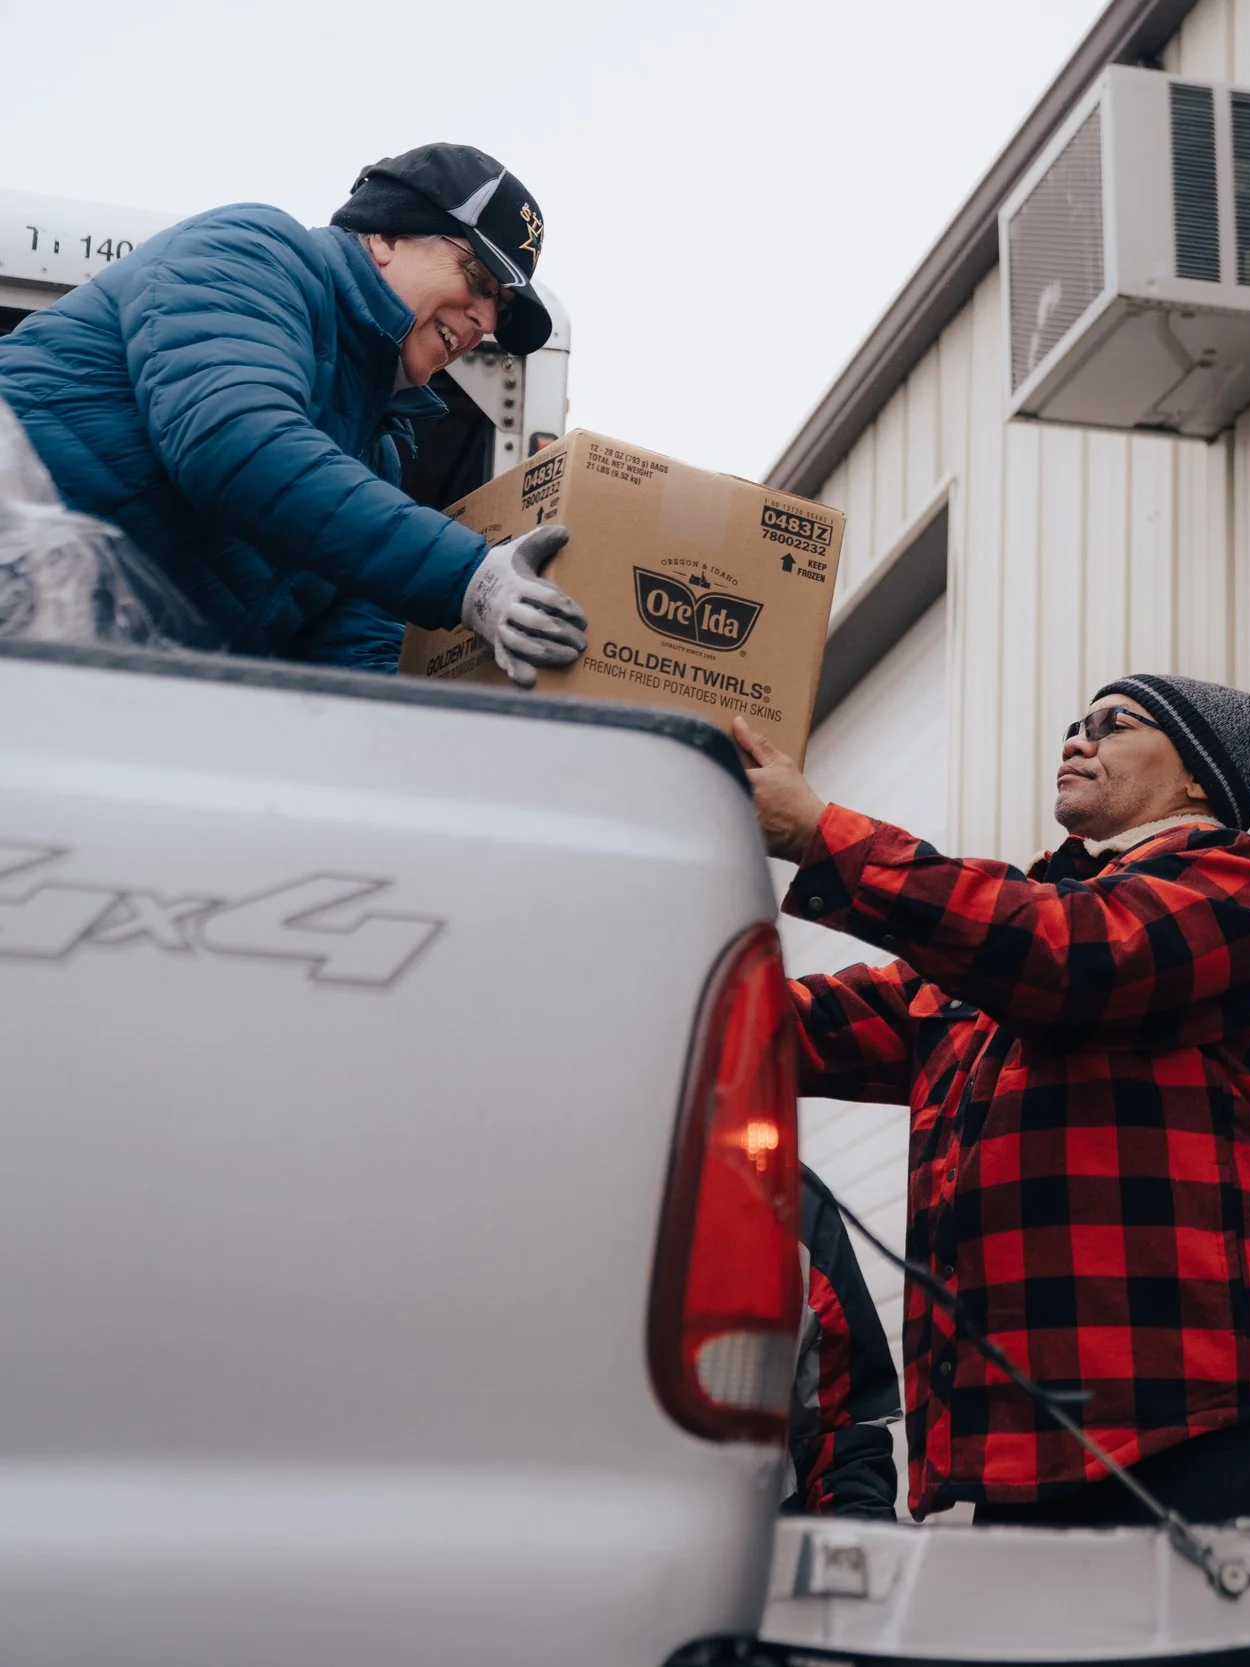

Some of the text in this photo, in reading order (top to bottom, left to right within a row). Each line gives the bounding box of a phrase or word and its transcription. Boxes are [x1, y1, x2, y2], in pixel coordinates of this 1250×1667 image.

[588, 452, 654, 479] TOTAL NET WEIGHT
[590, 443, 599, 452] 12
[604, 448, 613, 456] 28
[650, 462, 669, 474] BAGS
[586, 461, 642, 486] 21 LBS (9.52 kg)
[762, 528, 827, 557] 78002232
[661, 558, 699, 567] OREGON
[710, 566, 739, 586] IDAHO
[797, 568, 826, 583] FROZEN
[808, 559, 827, 571] KEEP
[646, 589, 739, 639] Ore Ida
[427, 641, 466, 676] GOLDEN
[602, 641, 687, 679] GOLDEN
[583, 657, 782, 723] FRENCH FRIED POTATOES WITH SKINS
